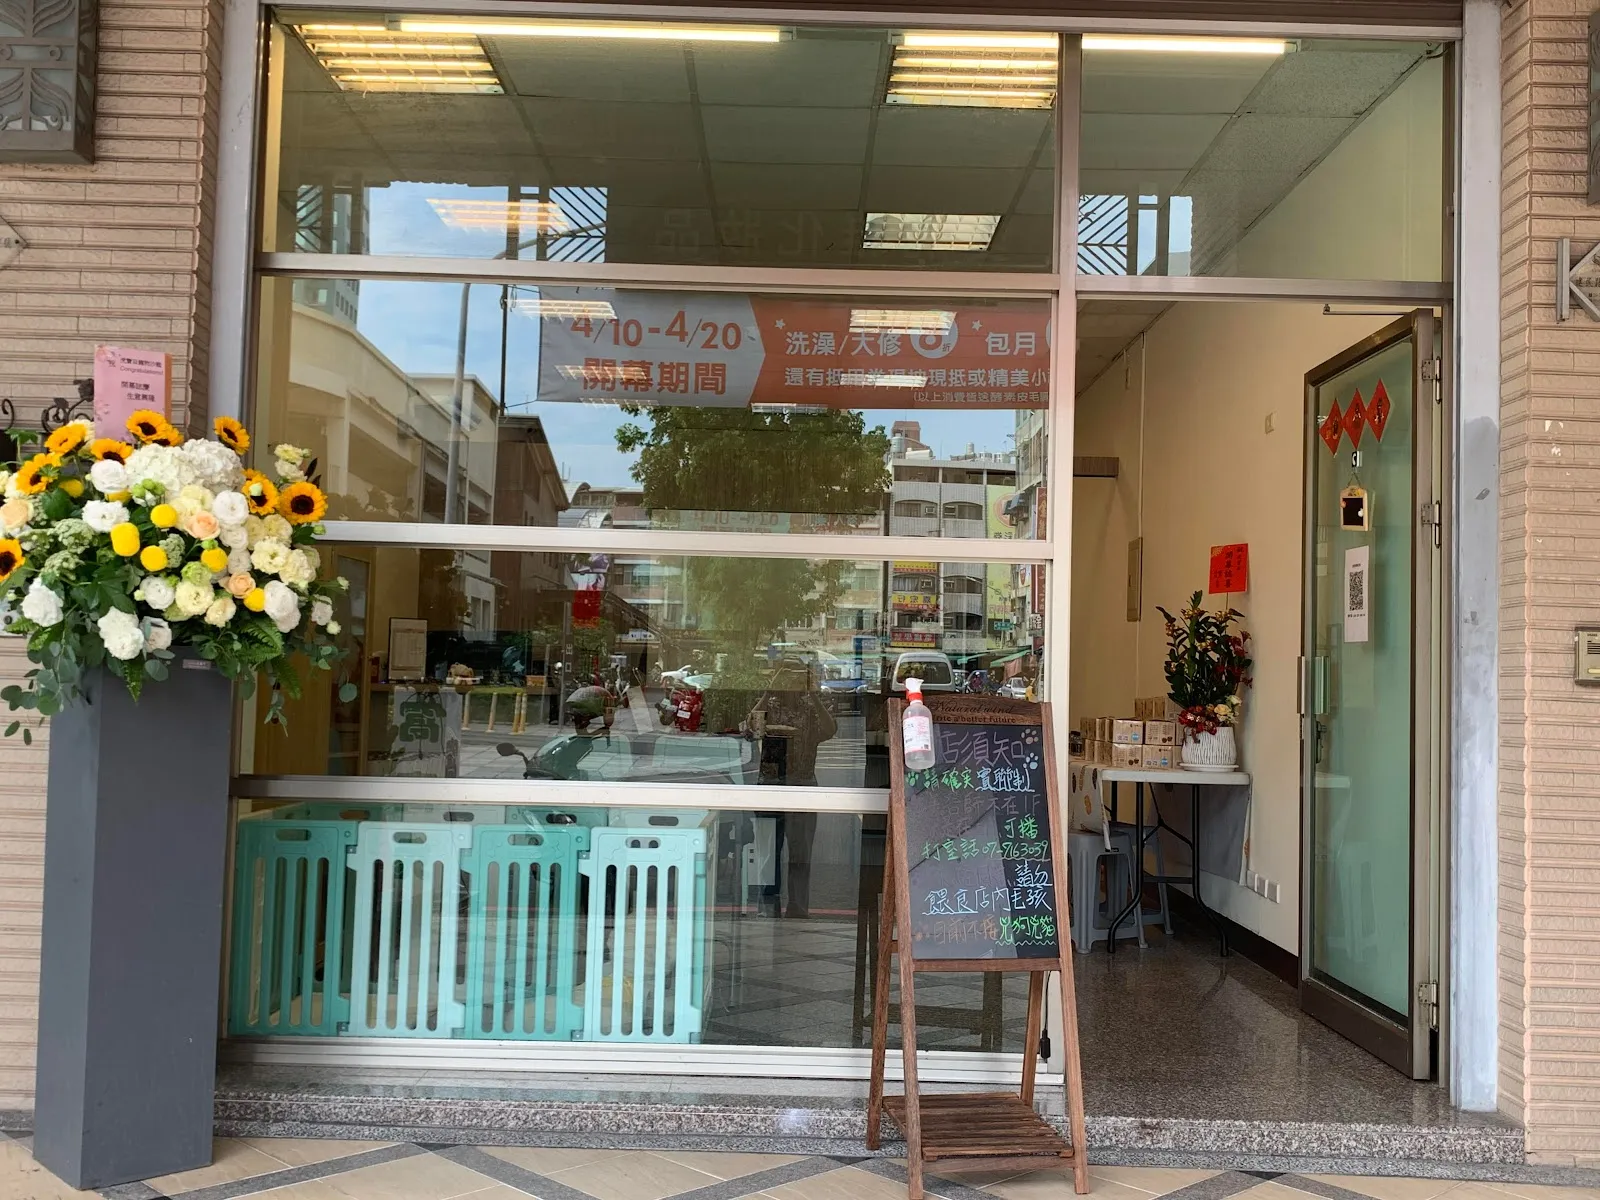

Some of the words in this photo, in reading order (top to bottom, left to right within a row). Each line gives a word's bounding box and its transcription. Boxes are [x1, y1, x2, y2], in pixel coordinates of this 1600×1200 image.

[570, 308, 742, 350] 4/10-4/20
[785, 331, 902, 356] 洗澡/大修
[985, 331, 1036, 356] 包月
[584, 357, 727, 396] 開幕期間
